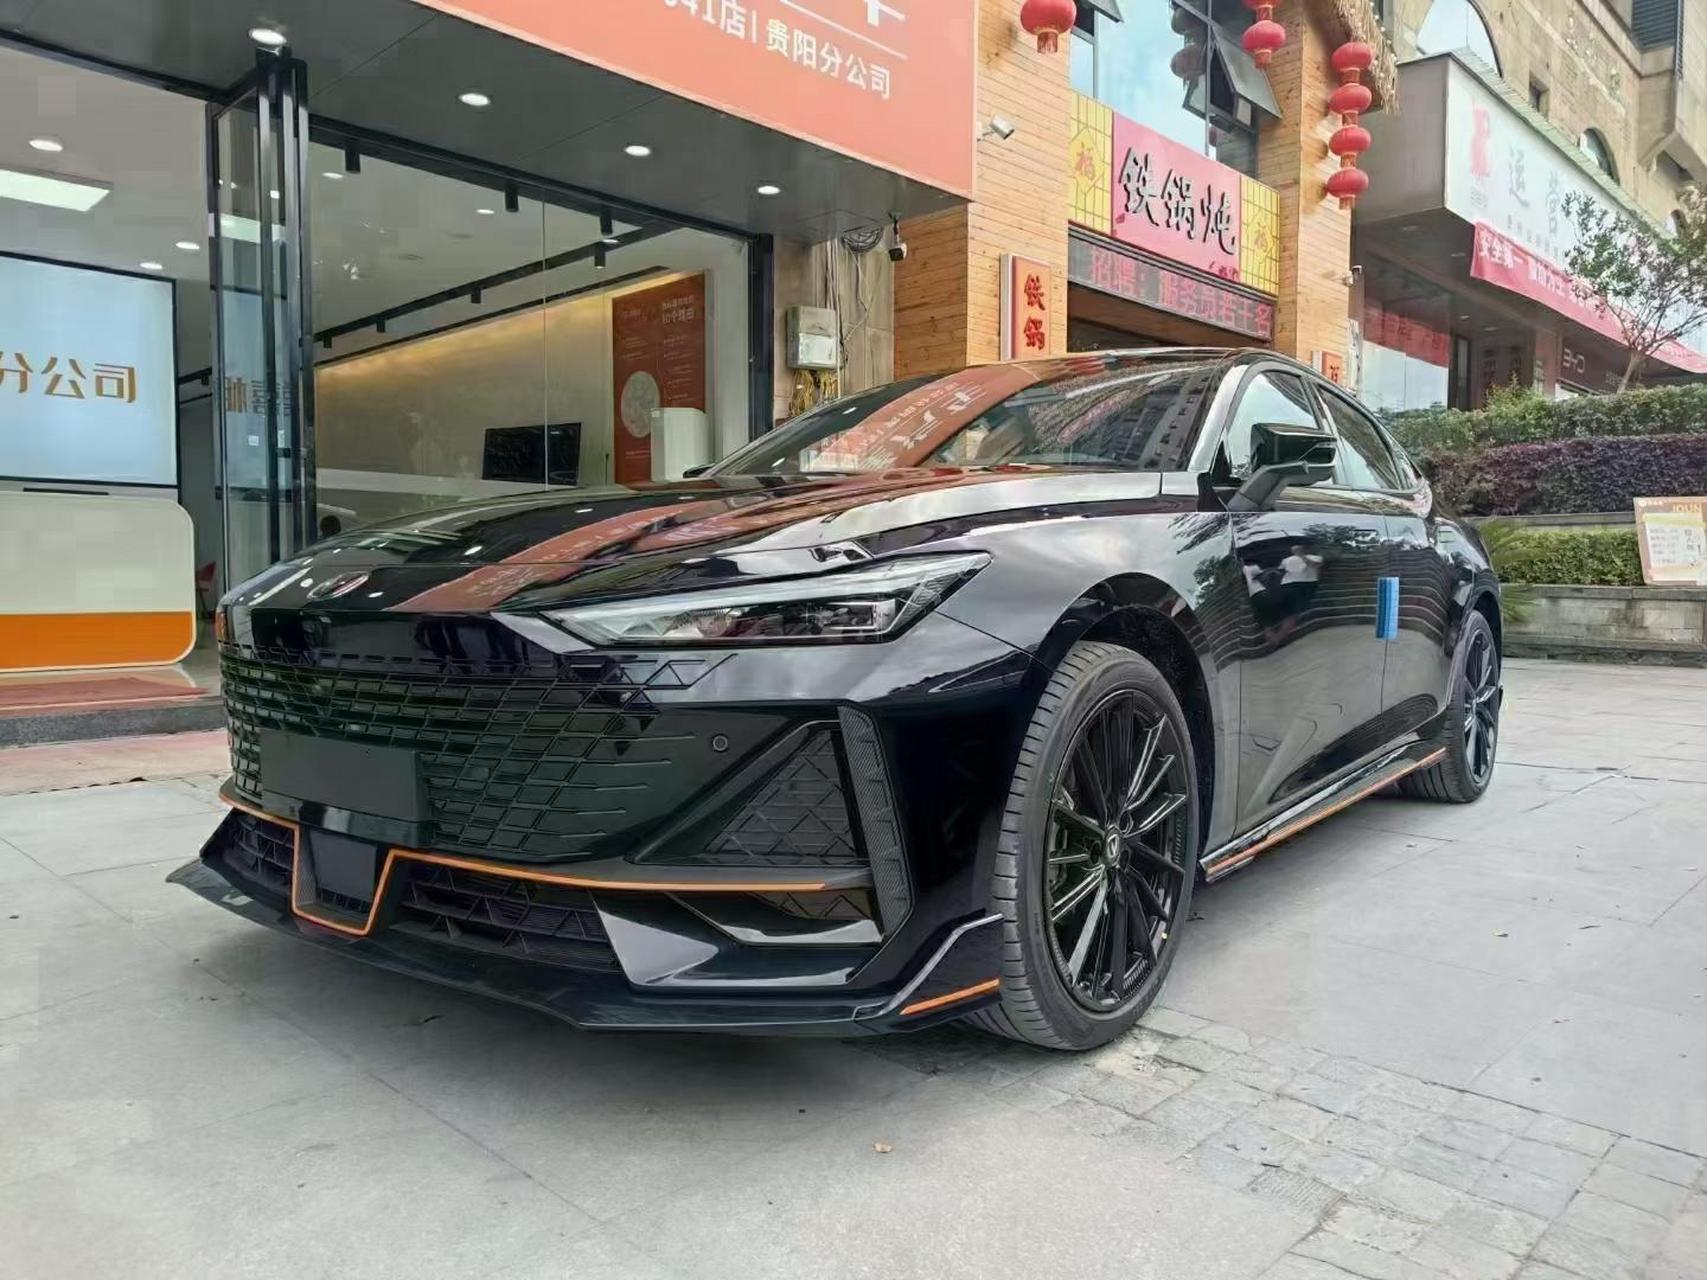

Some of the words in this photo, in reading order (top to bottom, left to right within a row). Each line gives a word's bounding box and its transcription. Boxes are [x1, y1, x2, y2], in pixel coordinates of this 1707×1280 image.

[766, 18, 890, 99] 贵阳分公司
[1118, 147, 1236, 255] 铁锅炖
[0, 351, 137, 404] 分公司
